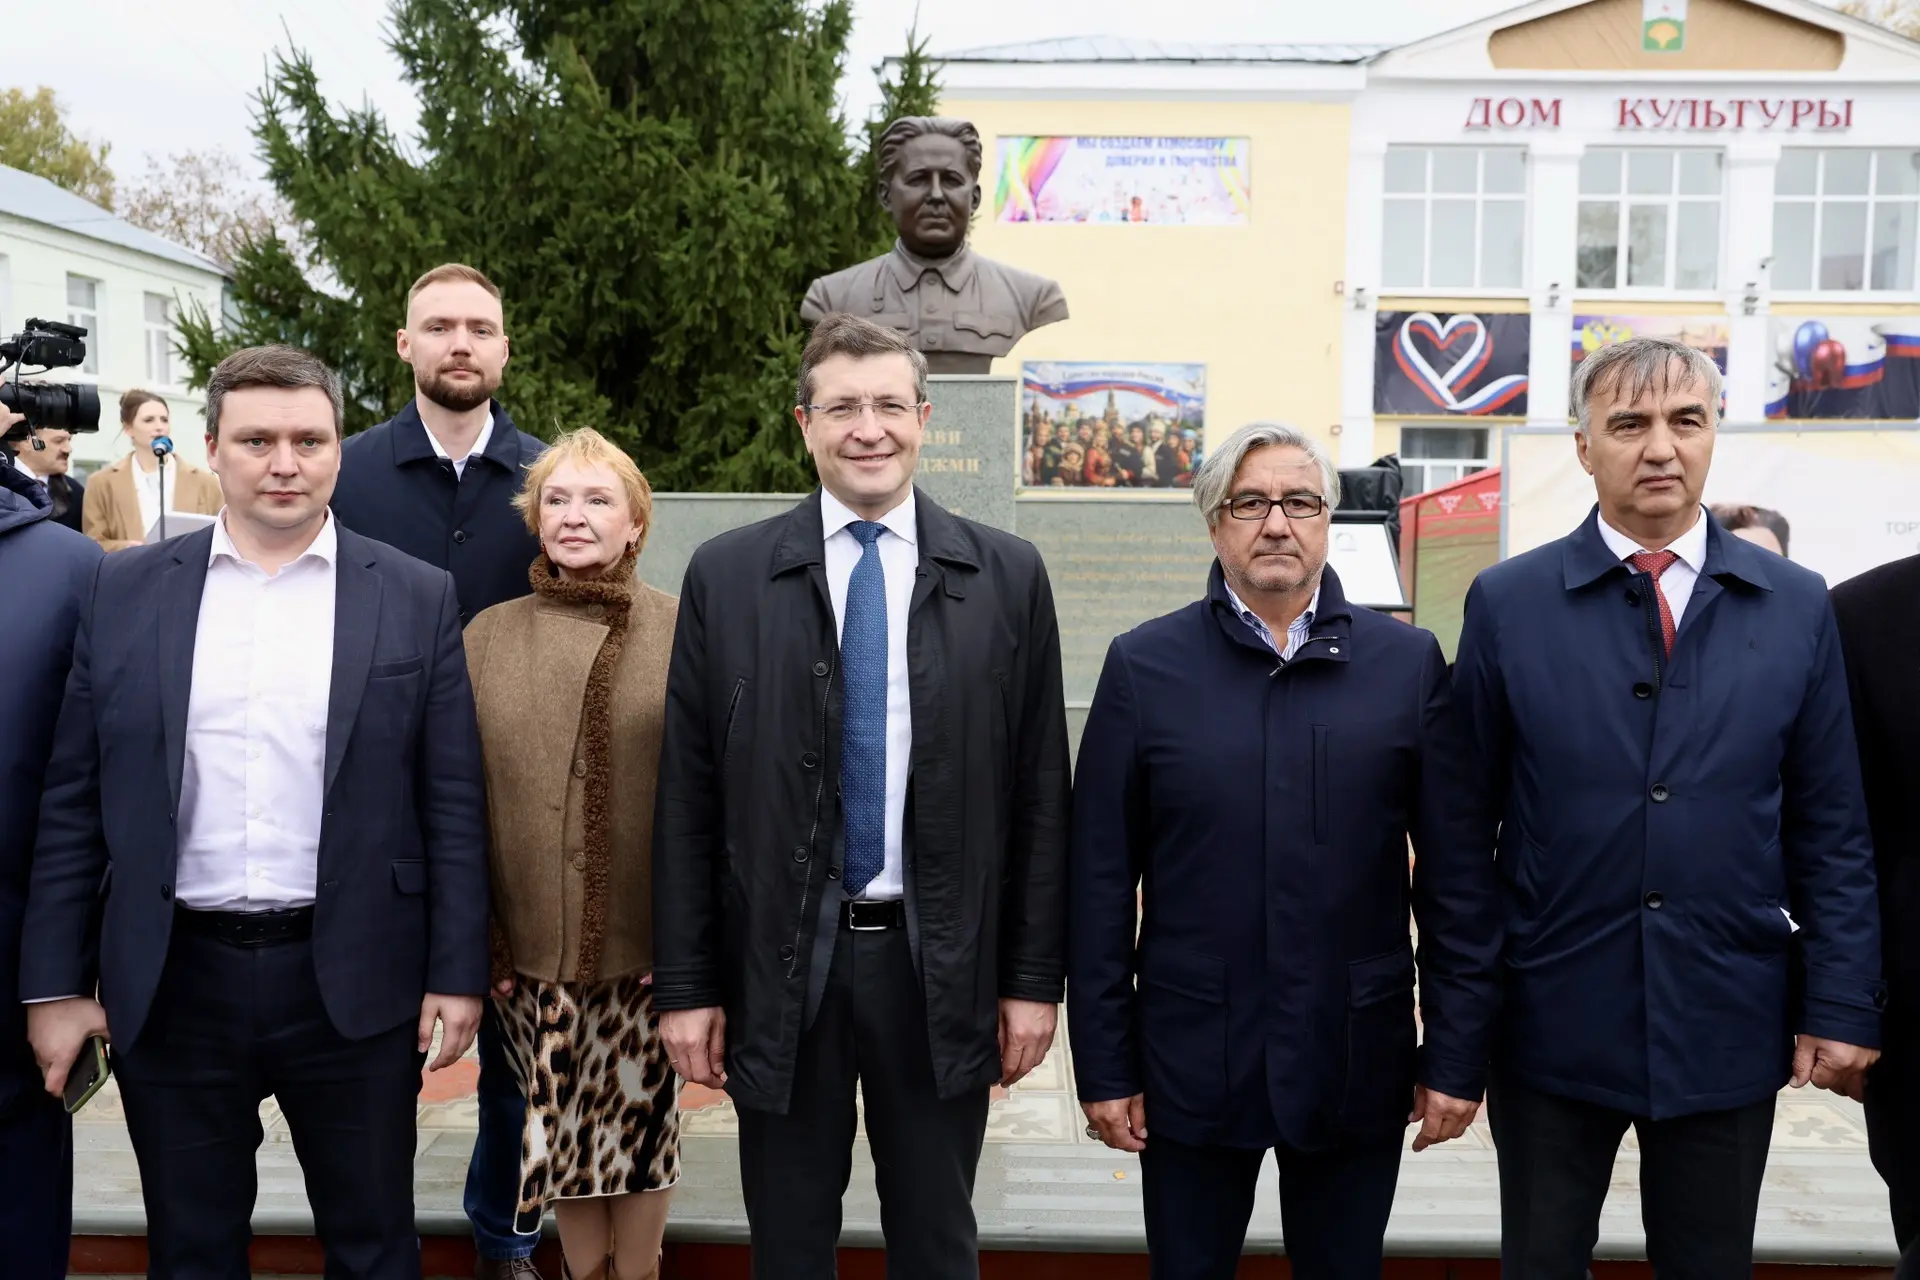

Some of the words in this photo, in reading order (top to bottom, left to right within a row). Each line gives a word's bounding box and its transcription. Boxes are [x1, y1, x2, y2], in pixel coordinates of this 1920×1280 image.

[1464, 98, 1562, 128] ДОМ
[1617, 98, 1855, 128] КУЛЬТУРЫ
[922, 430, 962, 445] АВИ
[919, 457, 980, 474] ДЖМИ
